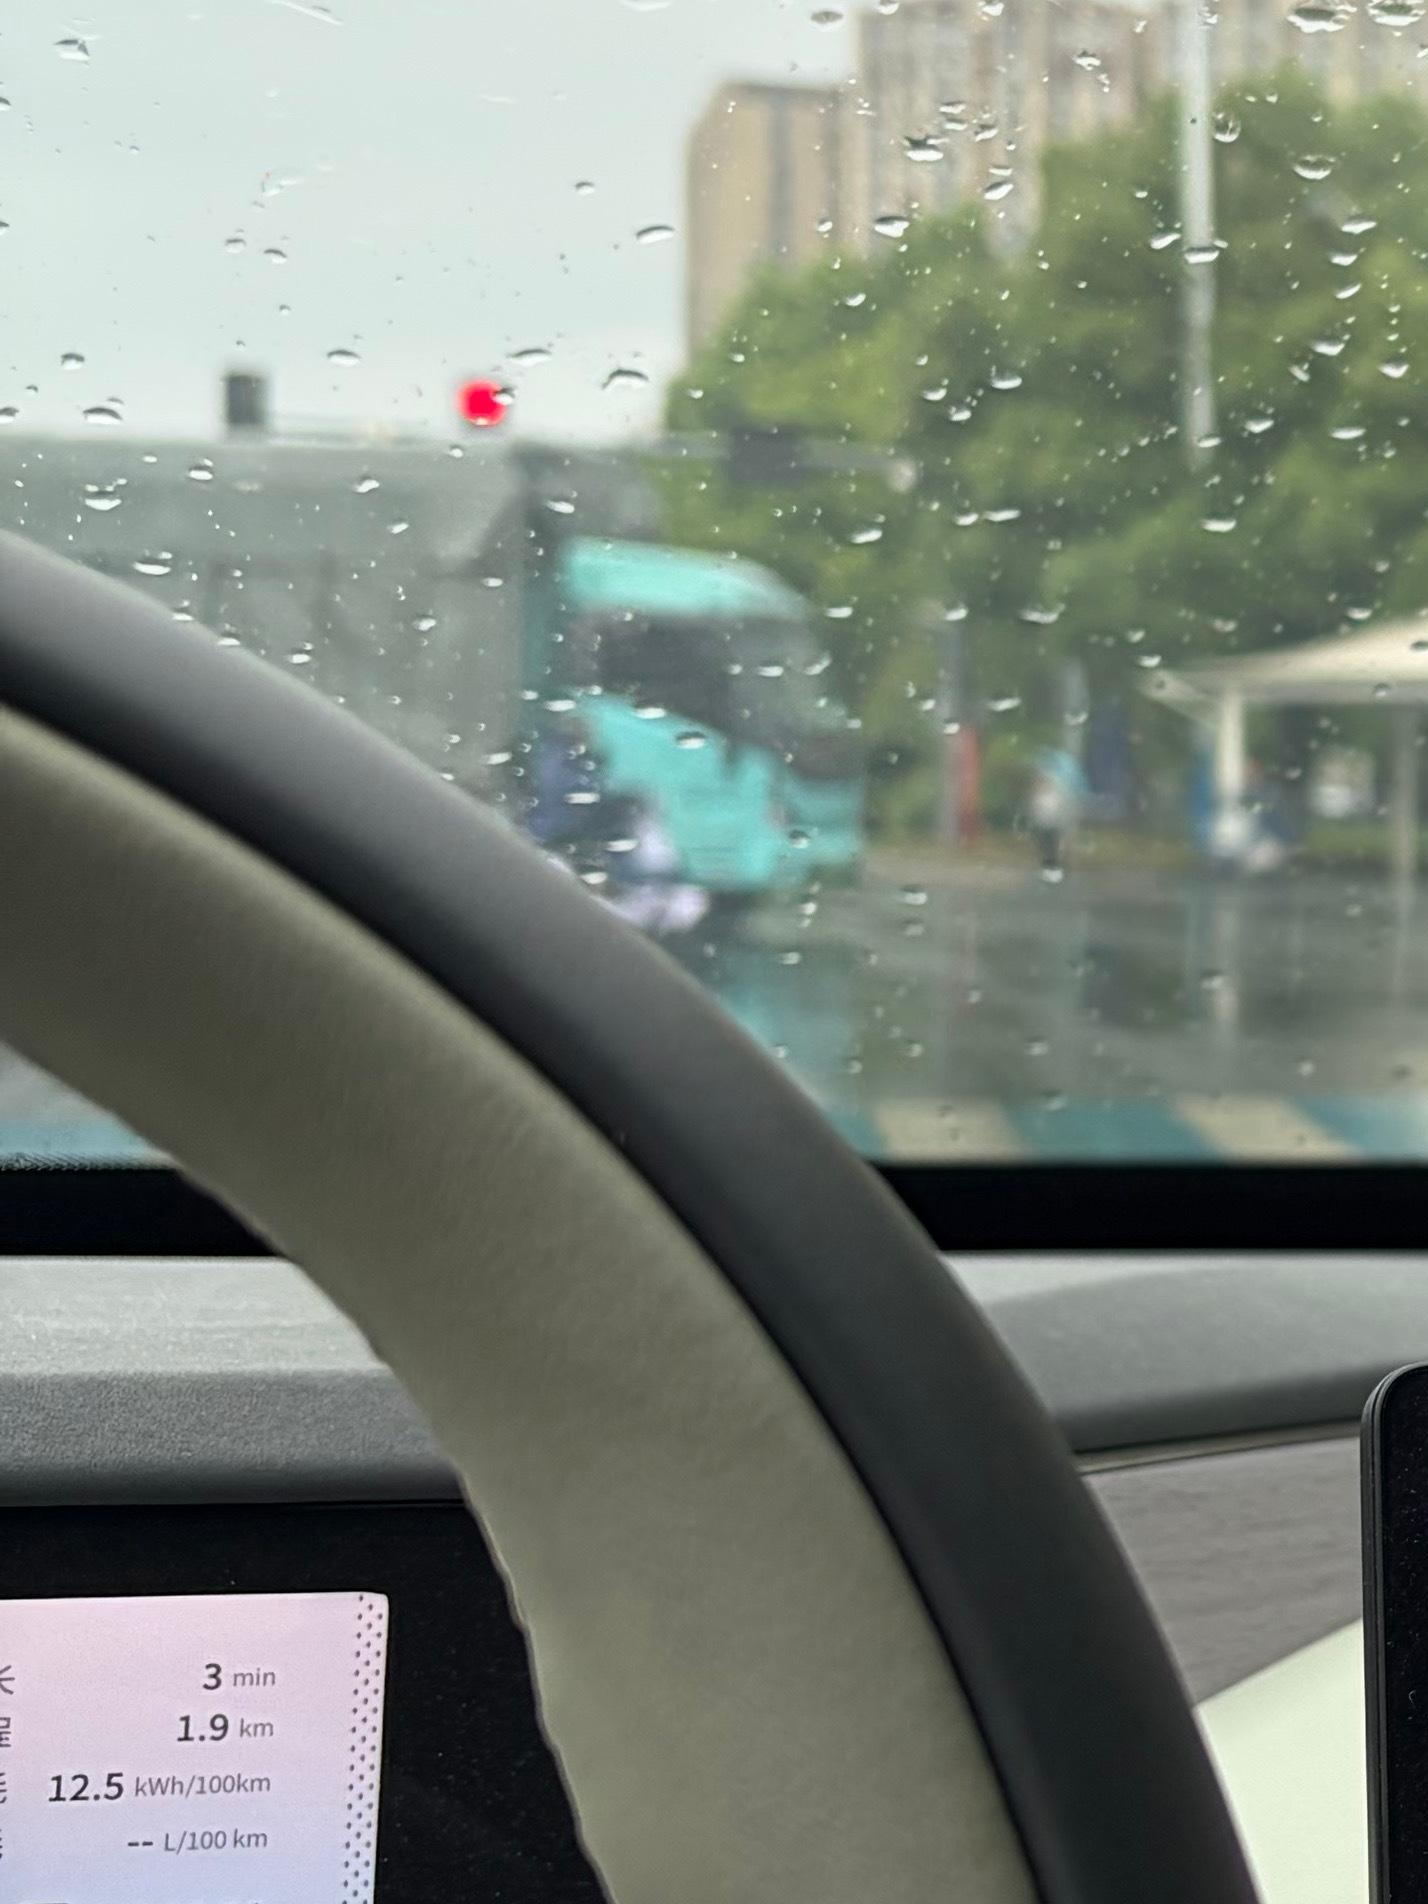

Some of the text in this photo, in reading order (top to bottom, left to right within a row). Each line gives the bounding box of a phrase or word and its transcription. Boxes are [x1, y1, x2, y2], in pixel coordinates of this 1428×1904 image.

[203, 1664, 276, 1690] 3 min
[177, 1714, 273, 1742] 1.9 km
[48, 1773, 271, 1802] 12.5 kWh/100km
